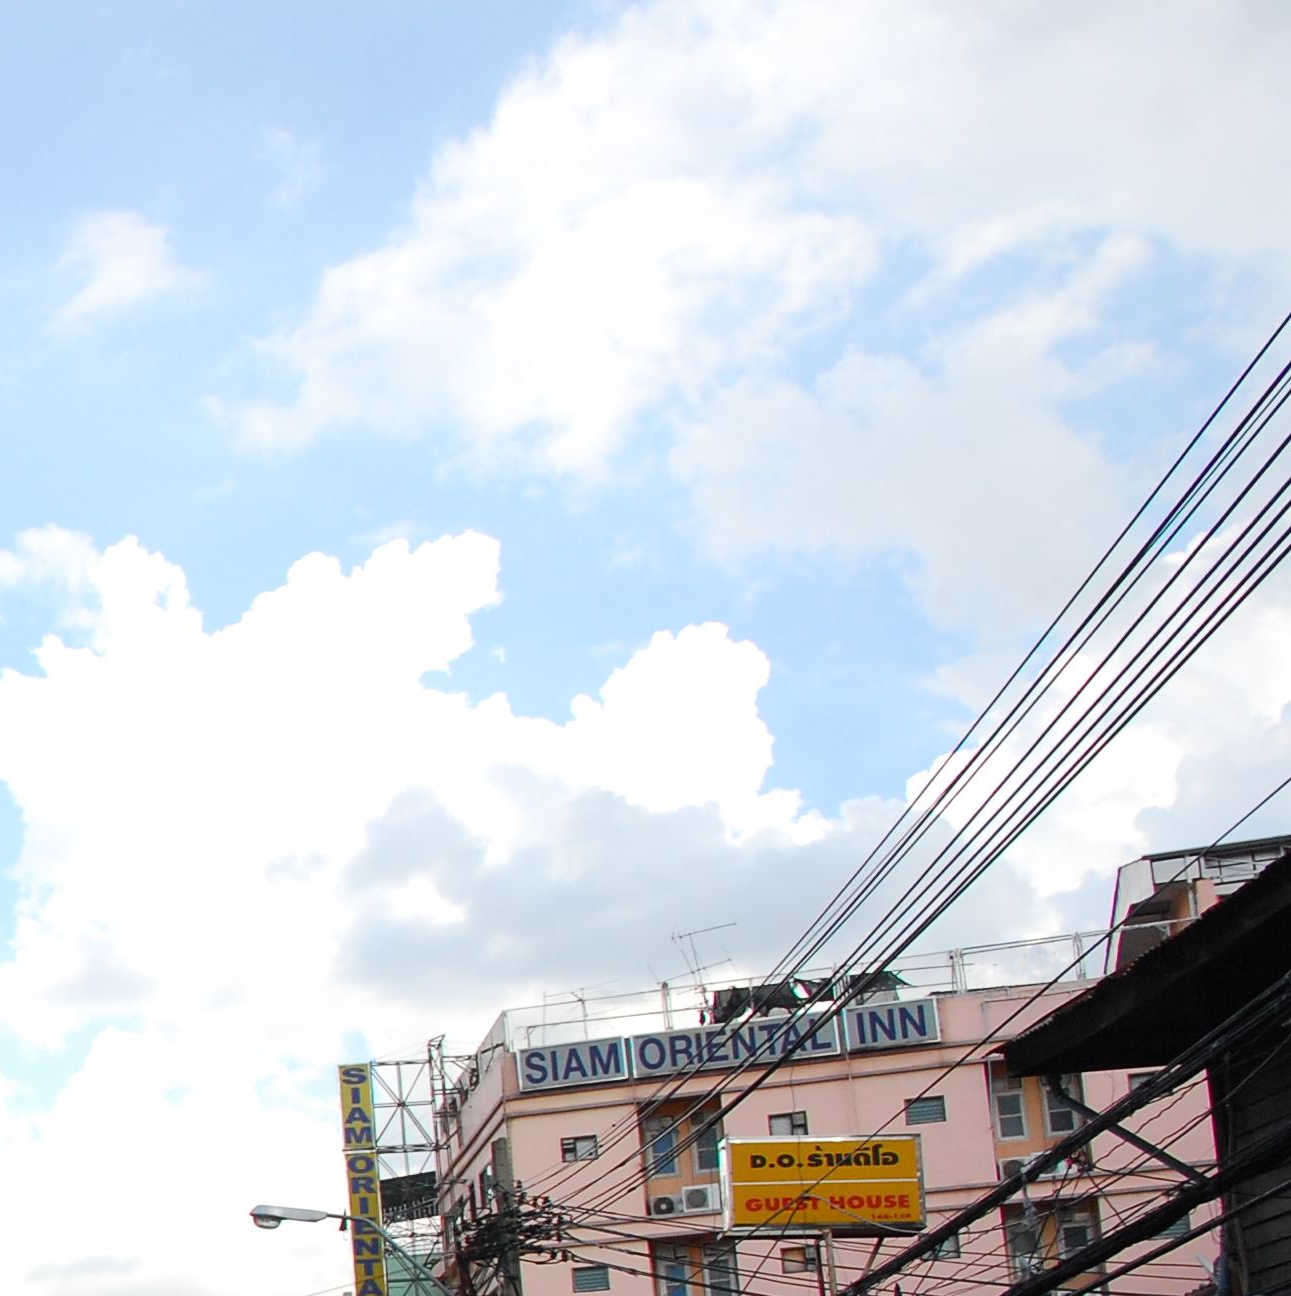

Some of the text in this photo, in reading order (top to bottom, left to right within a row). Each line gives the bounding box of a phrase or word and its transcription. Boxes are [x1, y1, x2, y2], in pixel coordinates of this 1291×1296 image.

[525, 1004, 928, 1085] SIAM ORIENTAL INN
[341, 1066, 372, 1143] SIAM
[745, 1194, 910, 1212] GUEST HOUSE
